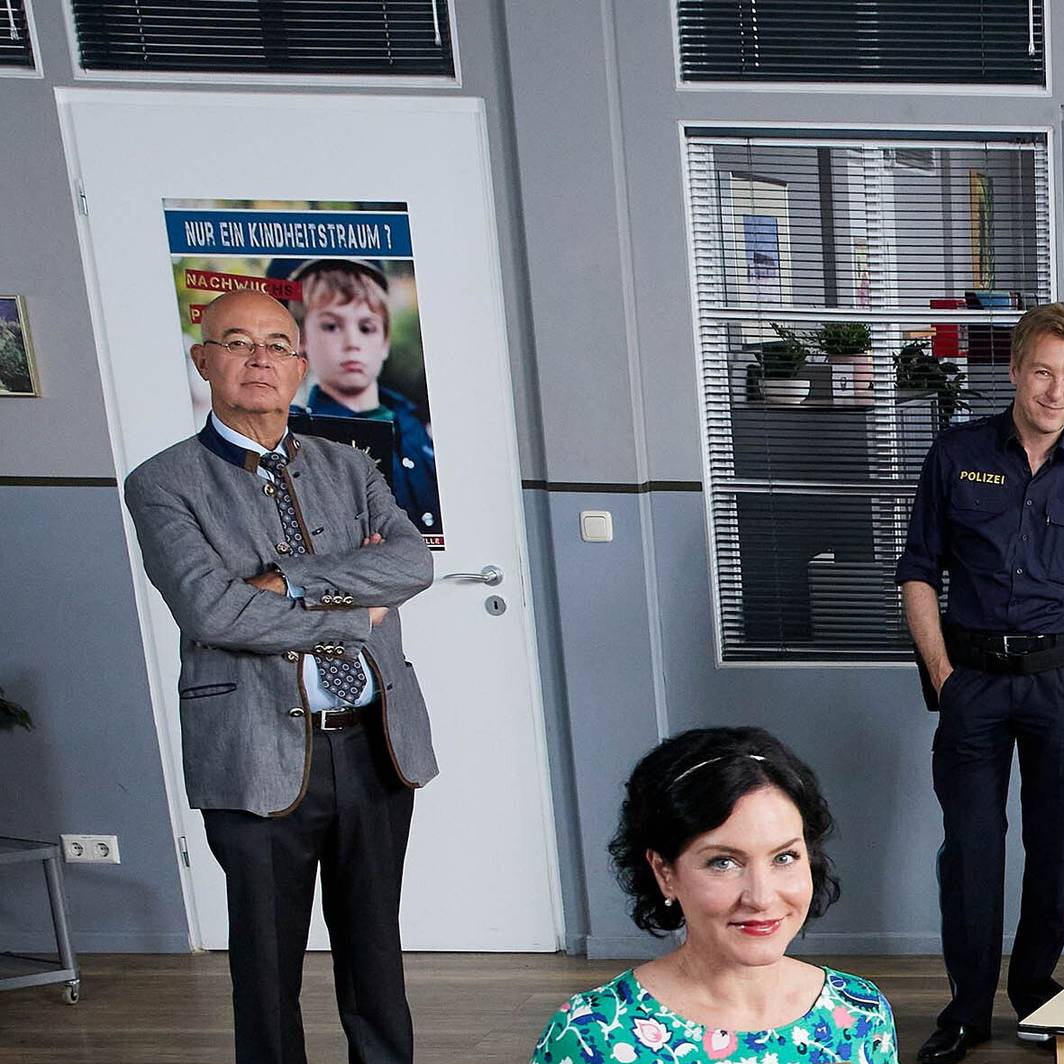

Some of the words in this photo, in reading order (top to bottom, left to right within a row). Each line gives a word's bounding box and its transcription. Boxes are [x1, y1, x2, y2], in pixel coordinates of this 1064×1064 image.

[184, 221, 216, 247] NUR
[219, 221, 246, 248] EIN
[248, 223, 381, 249] KINDHEITSTRAUM
[960, 470, 1005, 485] POLIZEI
